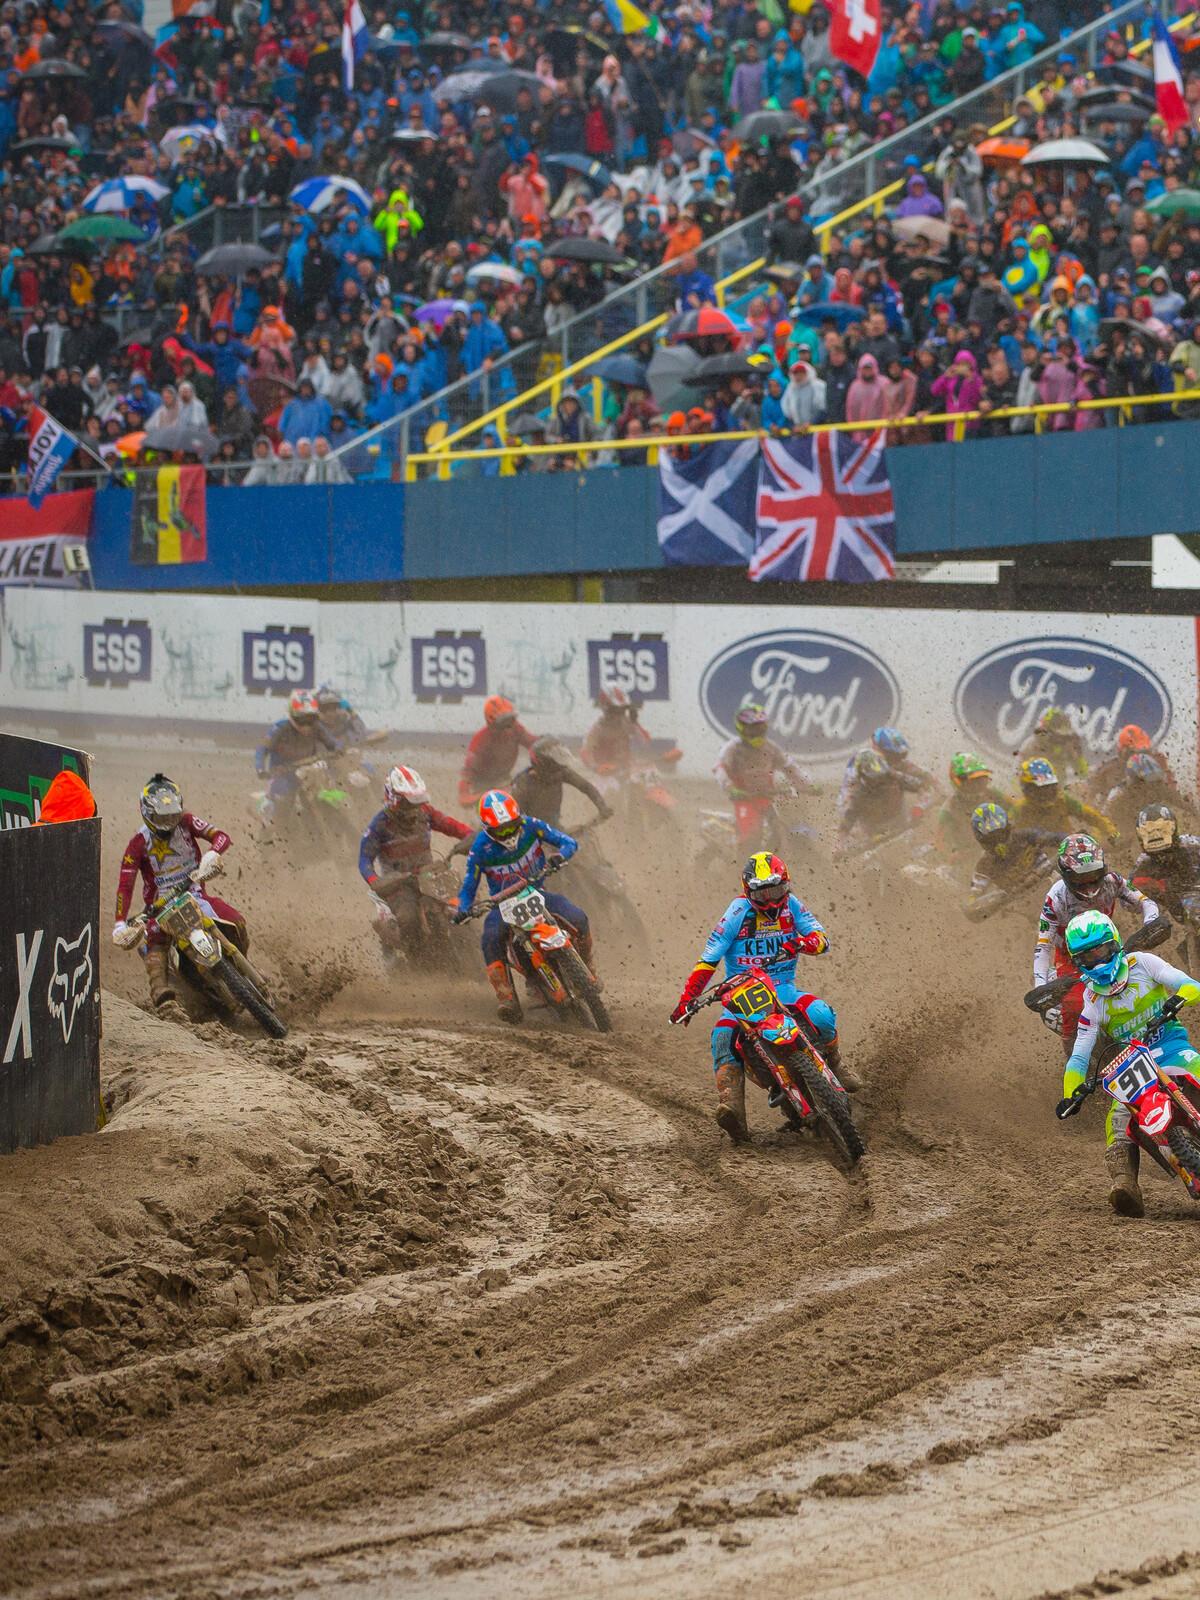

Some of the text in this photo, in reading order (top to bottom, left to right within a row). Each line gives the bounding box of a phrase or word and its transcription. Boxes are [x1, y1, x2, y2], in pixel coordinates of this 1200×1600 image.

[92, 632, 142, 674] ESS
[252, 639, 305, 682] ESS
[421, 645, 476, 688] ESS
[597, 649, 657, 693] ESS
[741, 648, 863, 741] Ford
[732, 982, 773, 1018] 16
[1117, 1057, 1153, 1101] 91
